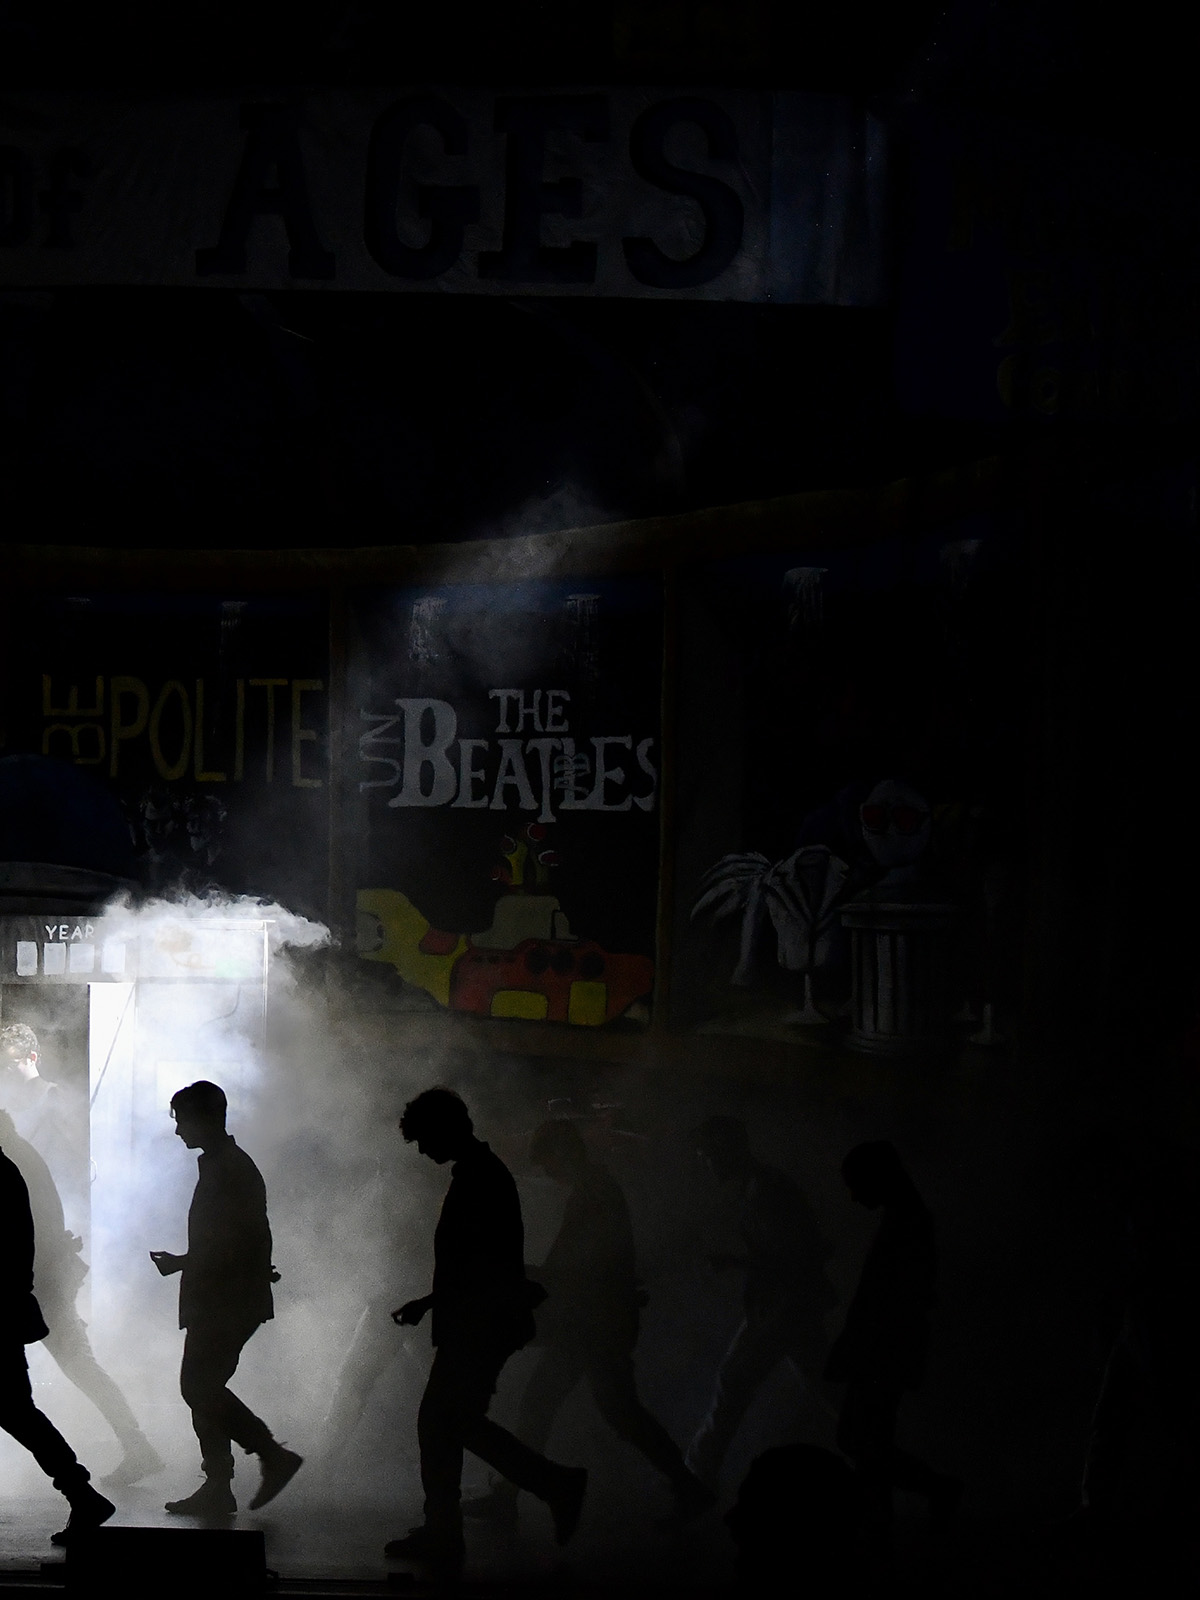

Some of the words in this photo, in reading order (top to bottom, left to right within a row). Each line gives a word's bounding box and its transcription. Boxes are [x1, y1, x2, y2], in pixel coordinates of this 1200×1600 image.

[196, 93, 746, 290] AGES
[40, 672, 107, 766] BE
[108, 672, 325, 789] POLITE
[388, 697, 659, 825] BEATLES
[488, 687, 572, 734] THE
[44, 924, 96, 940] YEAR
